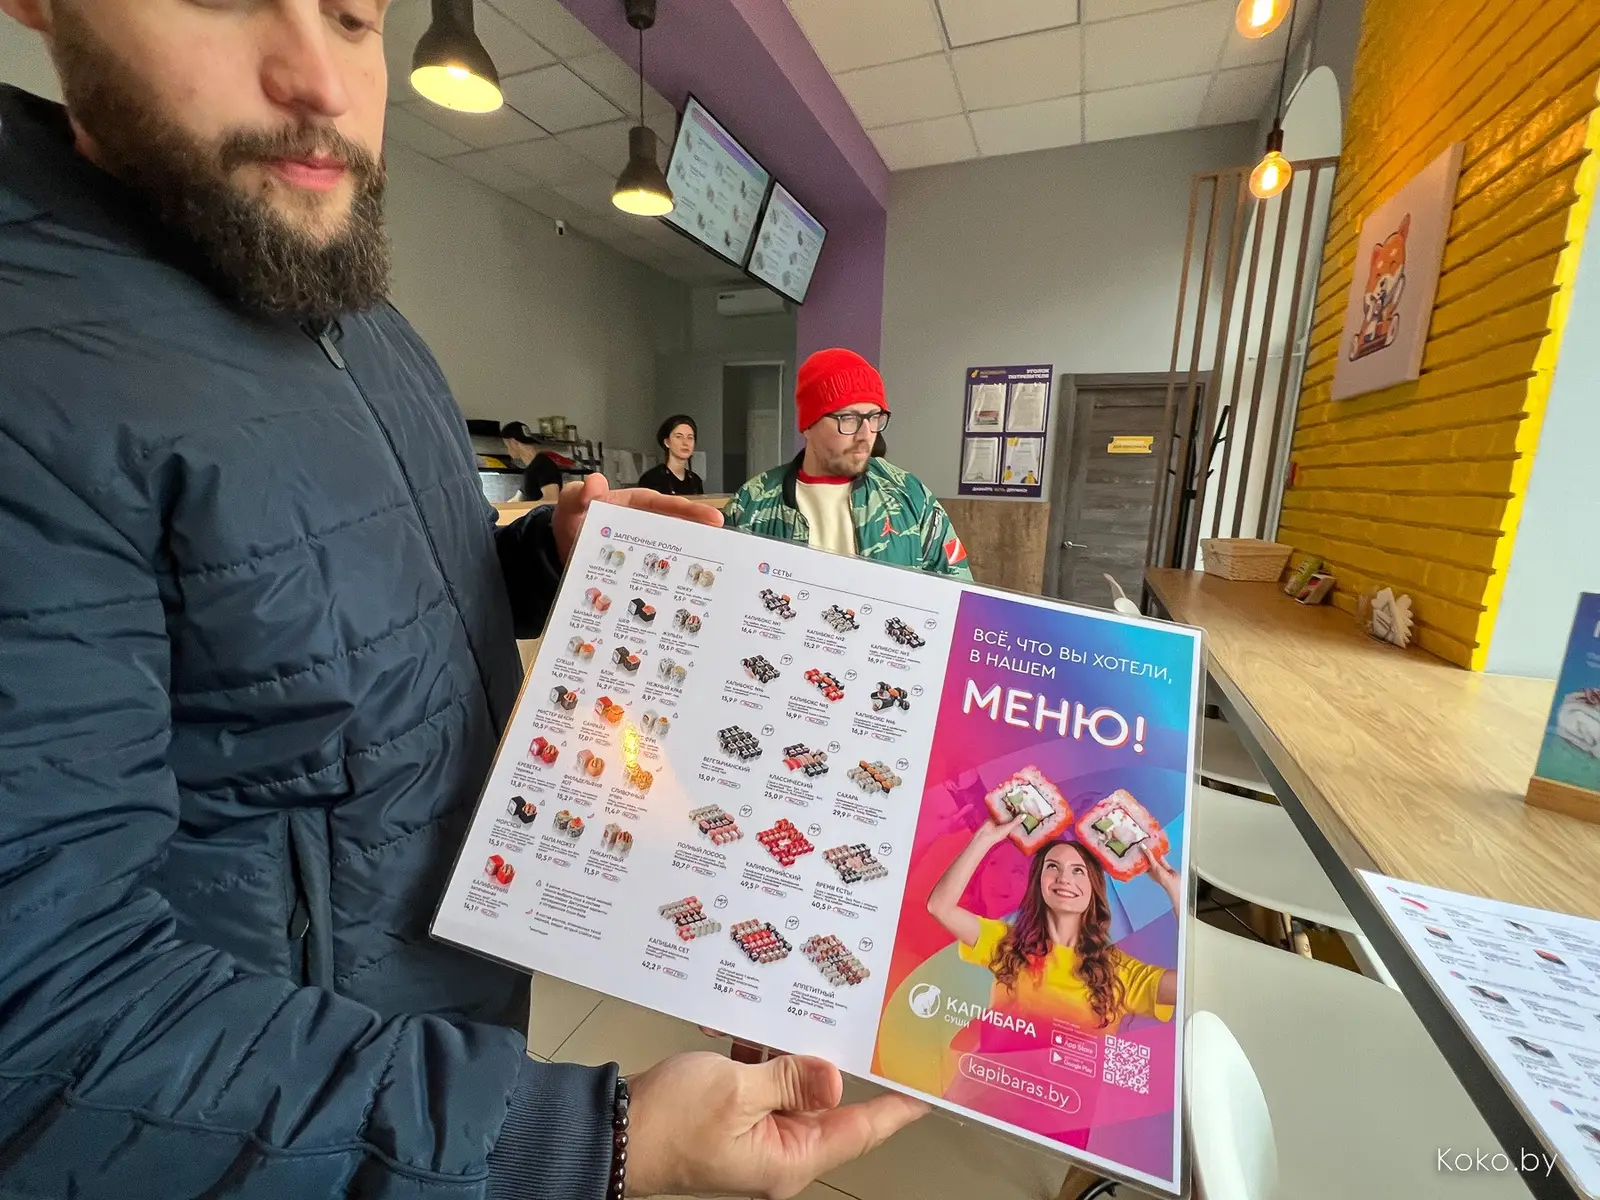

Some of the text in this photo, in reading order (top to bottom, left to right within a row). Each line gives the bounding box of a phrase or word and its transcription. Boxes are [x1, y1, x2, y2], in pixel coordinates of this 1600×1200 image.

[614, 532, 683, 553] ЗАПЕЧЕННЫЕ РОЛЛЫ
[772, 568, 793, 578] СЕТЫ
[973, 628, 1172, 685] ВСЁ, ЧТО ВЫ ХОТЕЛИ,
[969, 653, 1056, 680] В НАШЕМ
[962, 678, 1146, 755] МЕНЮ!
[517, 761, 542, 772] КРЕВЕТКА
[768, 774, 813, 790] КЛАССИЧЕСКИЙ
[764, 791, 778, 800] 25,0
[836, 791, 859, 801] САХАРА
[832, 809, 847, 818] 29,9
[590, 848, 624, 863] ПИКАНТНЫЙ
[676, 841, 702, 854] ПОЛНЫЙ
[702, 848, 727, 861] ЛОСОСЬ
[745, 860, 802, 882] КАЛИФОРНИЙСКИЙ
[815, 881, 836, 891] ВРЕМЯ
[811, 900, 827, 910] 40,5
[648, 936, 678, 952] КАПИБАРА
[678, 945, 691, 955] СЕТ
[641, 960, 657, 972] 42,2
[719, 958, 736, 969] АЗИЯ
[792, 981, 836, 999] АППЕТИТНЫЙ
[786, 1006, 803, 1016] 62,0
[946, 996, 1037, 1039] КАПИБАРА
[1064, 1040, 1094, 1054] App Store
[968, 1057, 1070, 1108] kapibaras.by
